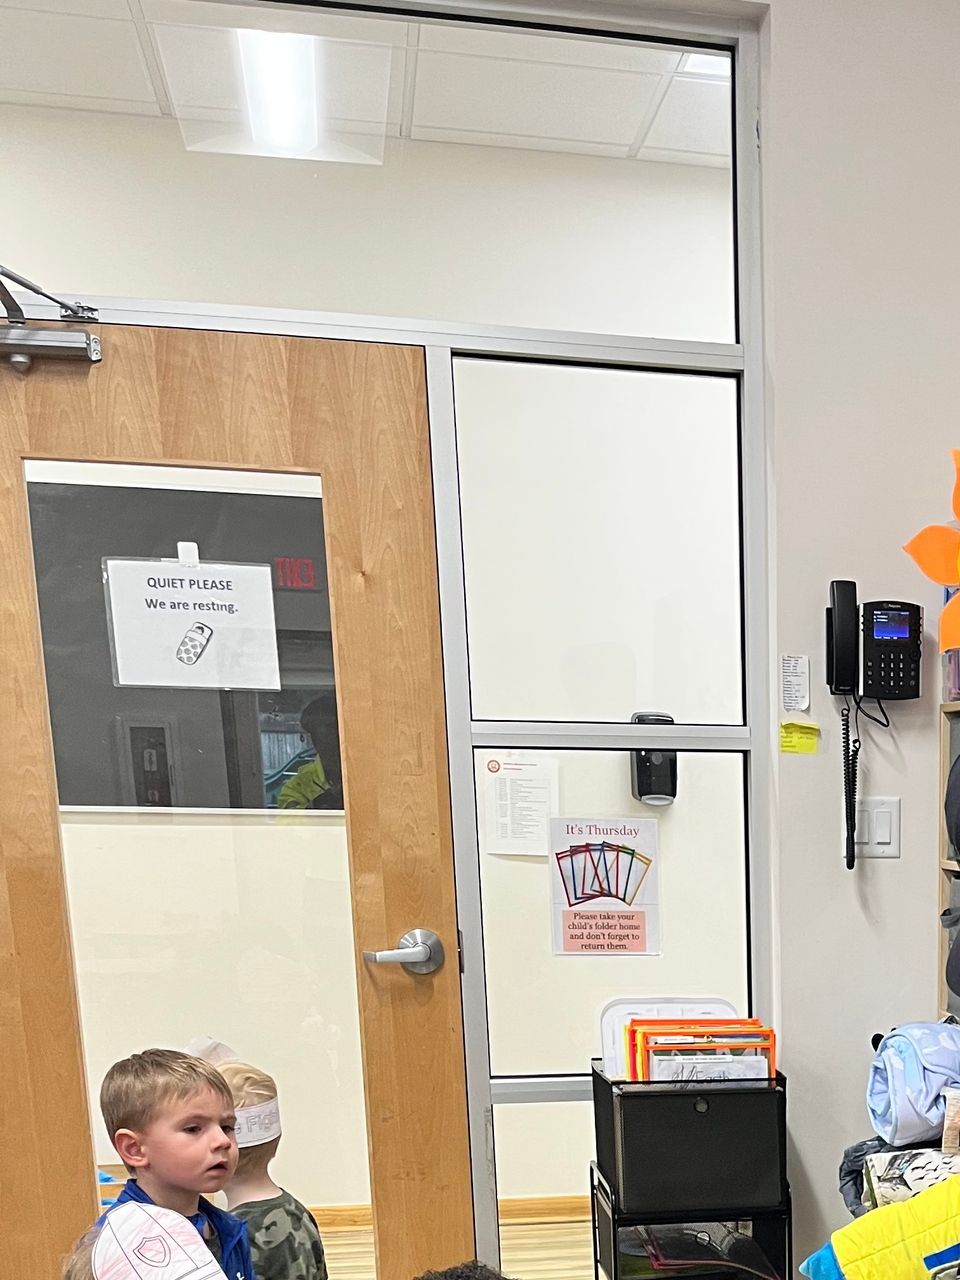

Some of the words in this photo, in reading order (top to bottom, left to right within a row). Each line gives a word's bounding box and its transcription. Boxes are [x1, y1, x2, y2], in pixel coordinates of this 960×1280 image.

[147, 577, 185, 590] QUIET
[189, 579, 233, 591] PLEASE
[145, 598, 166, 610] We
[170, 601, 189, 611] are
[193, 601, 238, 615] resting.
[565, 824, 583, 836] It's
[586, 825, 640, 839] Thursday
[573, 912, 598, 920] Please
[599, 912, 616, 920] take
[617, 914, 635, 922] your
[568, 922, 593, 930] child's
[594, 922, 617, 930] folder
[619, 922, 641, 930] home
[569, 932, 584, 940] and
[585, 932, 606, 940] don't
[607, 932, 630, 942] forget
[580, 943, 605, 951] return
